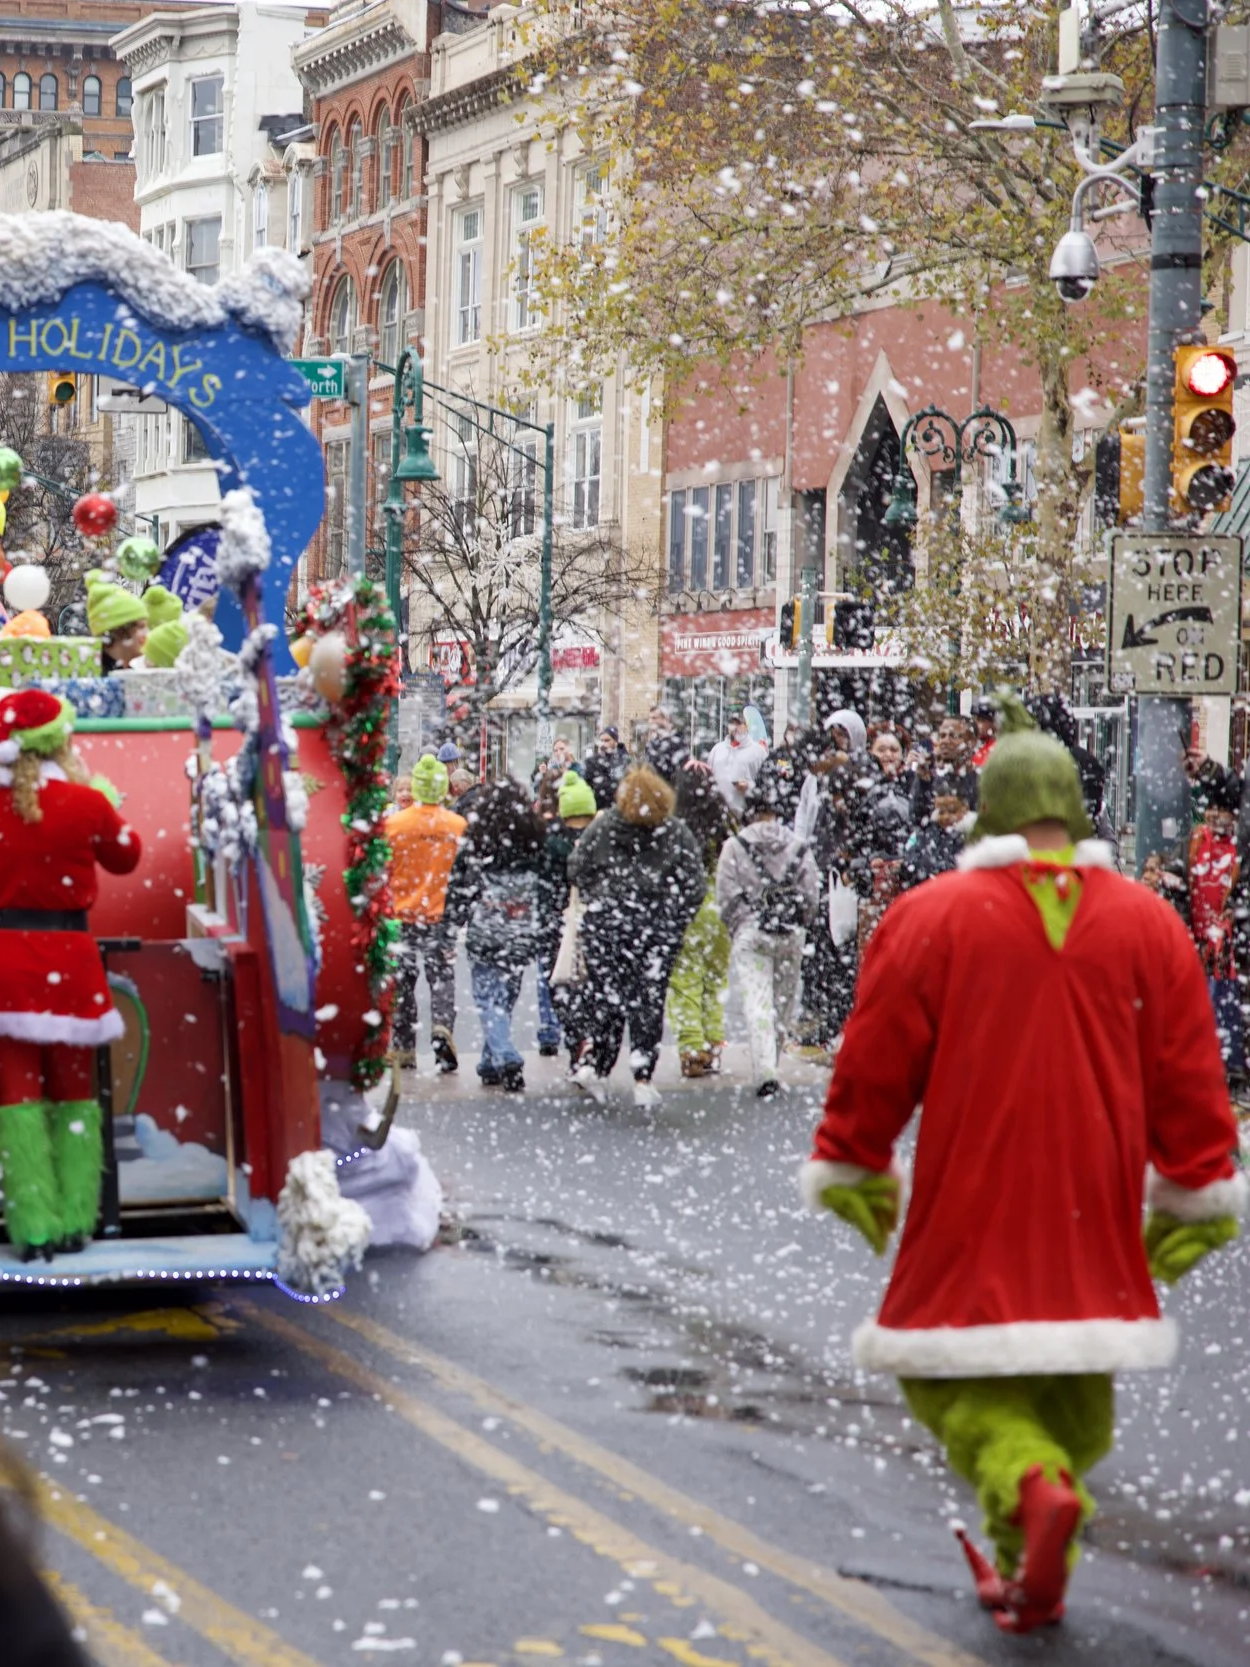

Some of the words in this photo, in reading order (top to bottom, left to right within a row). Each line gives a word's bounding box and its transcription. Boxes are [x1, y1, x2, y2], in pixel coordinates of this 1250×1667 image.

[8, 317, 222, 409] HOLIDAYS
[305, 378, 338, 394] orth
[1132, 549, 1222, 577] STOP
[1148, 584, 1203, 601] HERE
[718, 635, 736, 648] GOOD
[1156, 653, 1225, 683] RED
